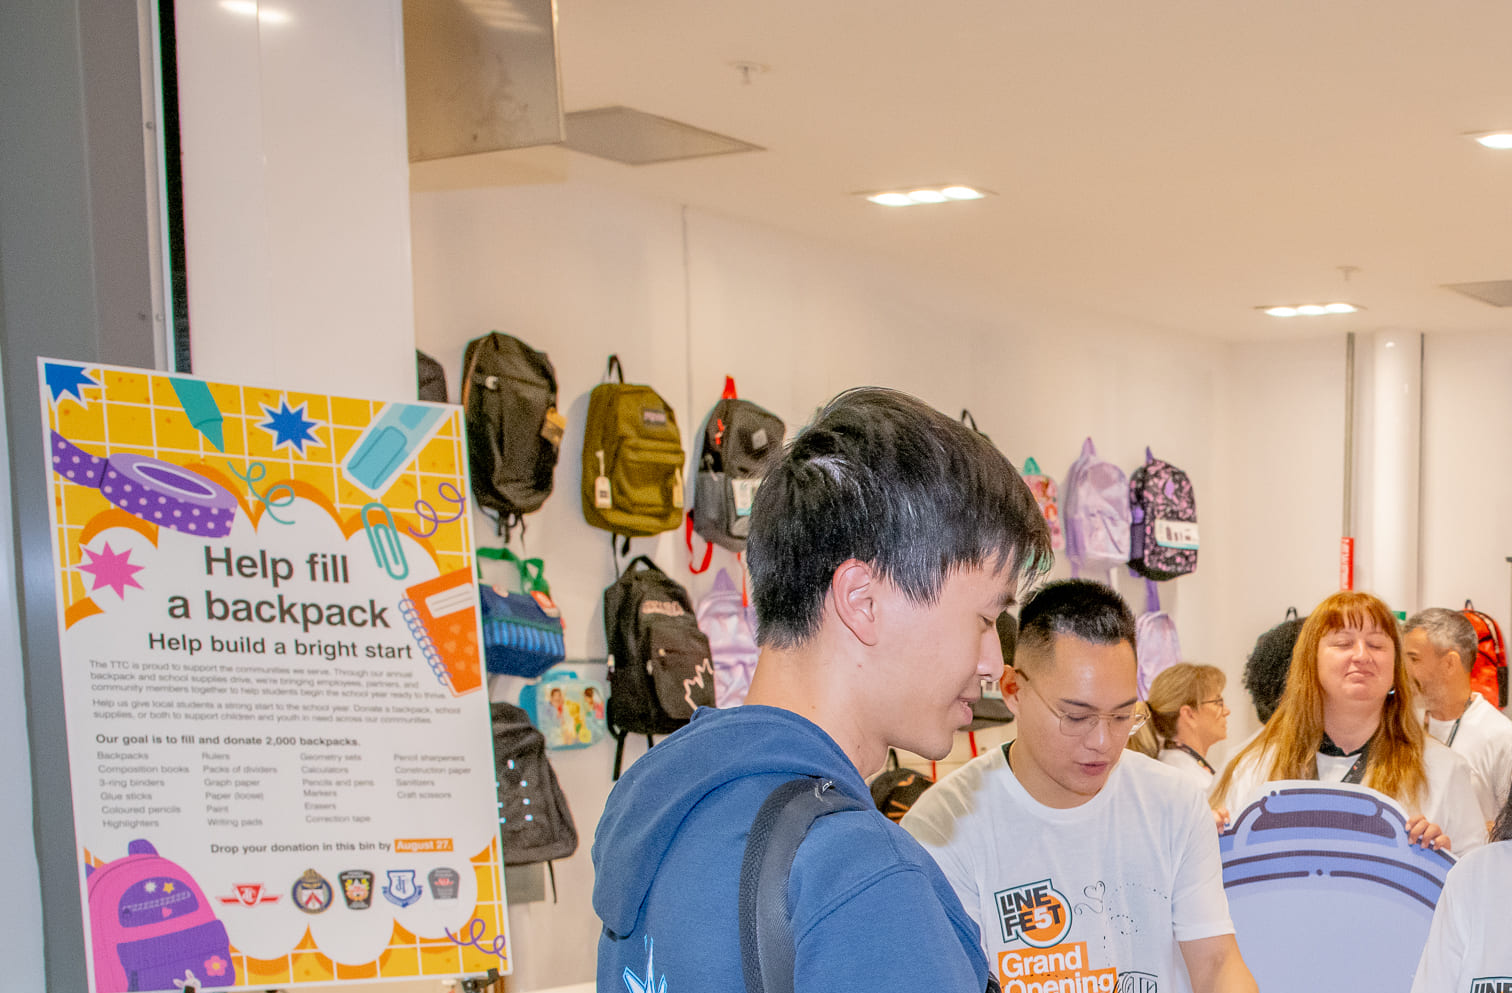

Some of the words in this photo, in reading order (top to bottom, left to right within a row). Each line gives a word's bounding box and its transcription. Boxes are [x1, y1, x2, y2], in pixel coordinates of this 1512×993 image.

[204, 545, 293, 587] Help
[306, 553, 350, 584] fill
[168, 594, 191, 620] a
[205, 590, 391, 632] backpack
[148, 632, 202, 656] Help
[211, 635, 266, 655] build
[274, 641, 286, 655] a
[294, 639, 358, 661] bright
[365, 643, 413, 660] start
[210, 842, 239, 855] Drop
[242, 844, 267, 854] your
[270, 842, 320, 853] donation
[322, 841, 332, 851] in
[335, 841, 355, 851] this
[358, 840, 375, 850] bin
[379, 841, 391, 852] by
[397, 839, 432, 852] August
[999, 884, 1052, 915] LINE
[1003, 902, 1062, 938] FE5T
[1001, 945, 1083, 979] Grand
